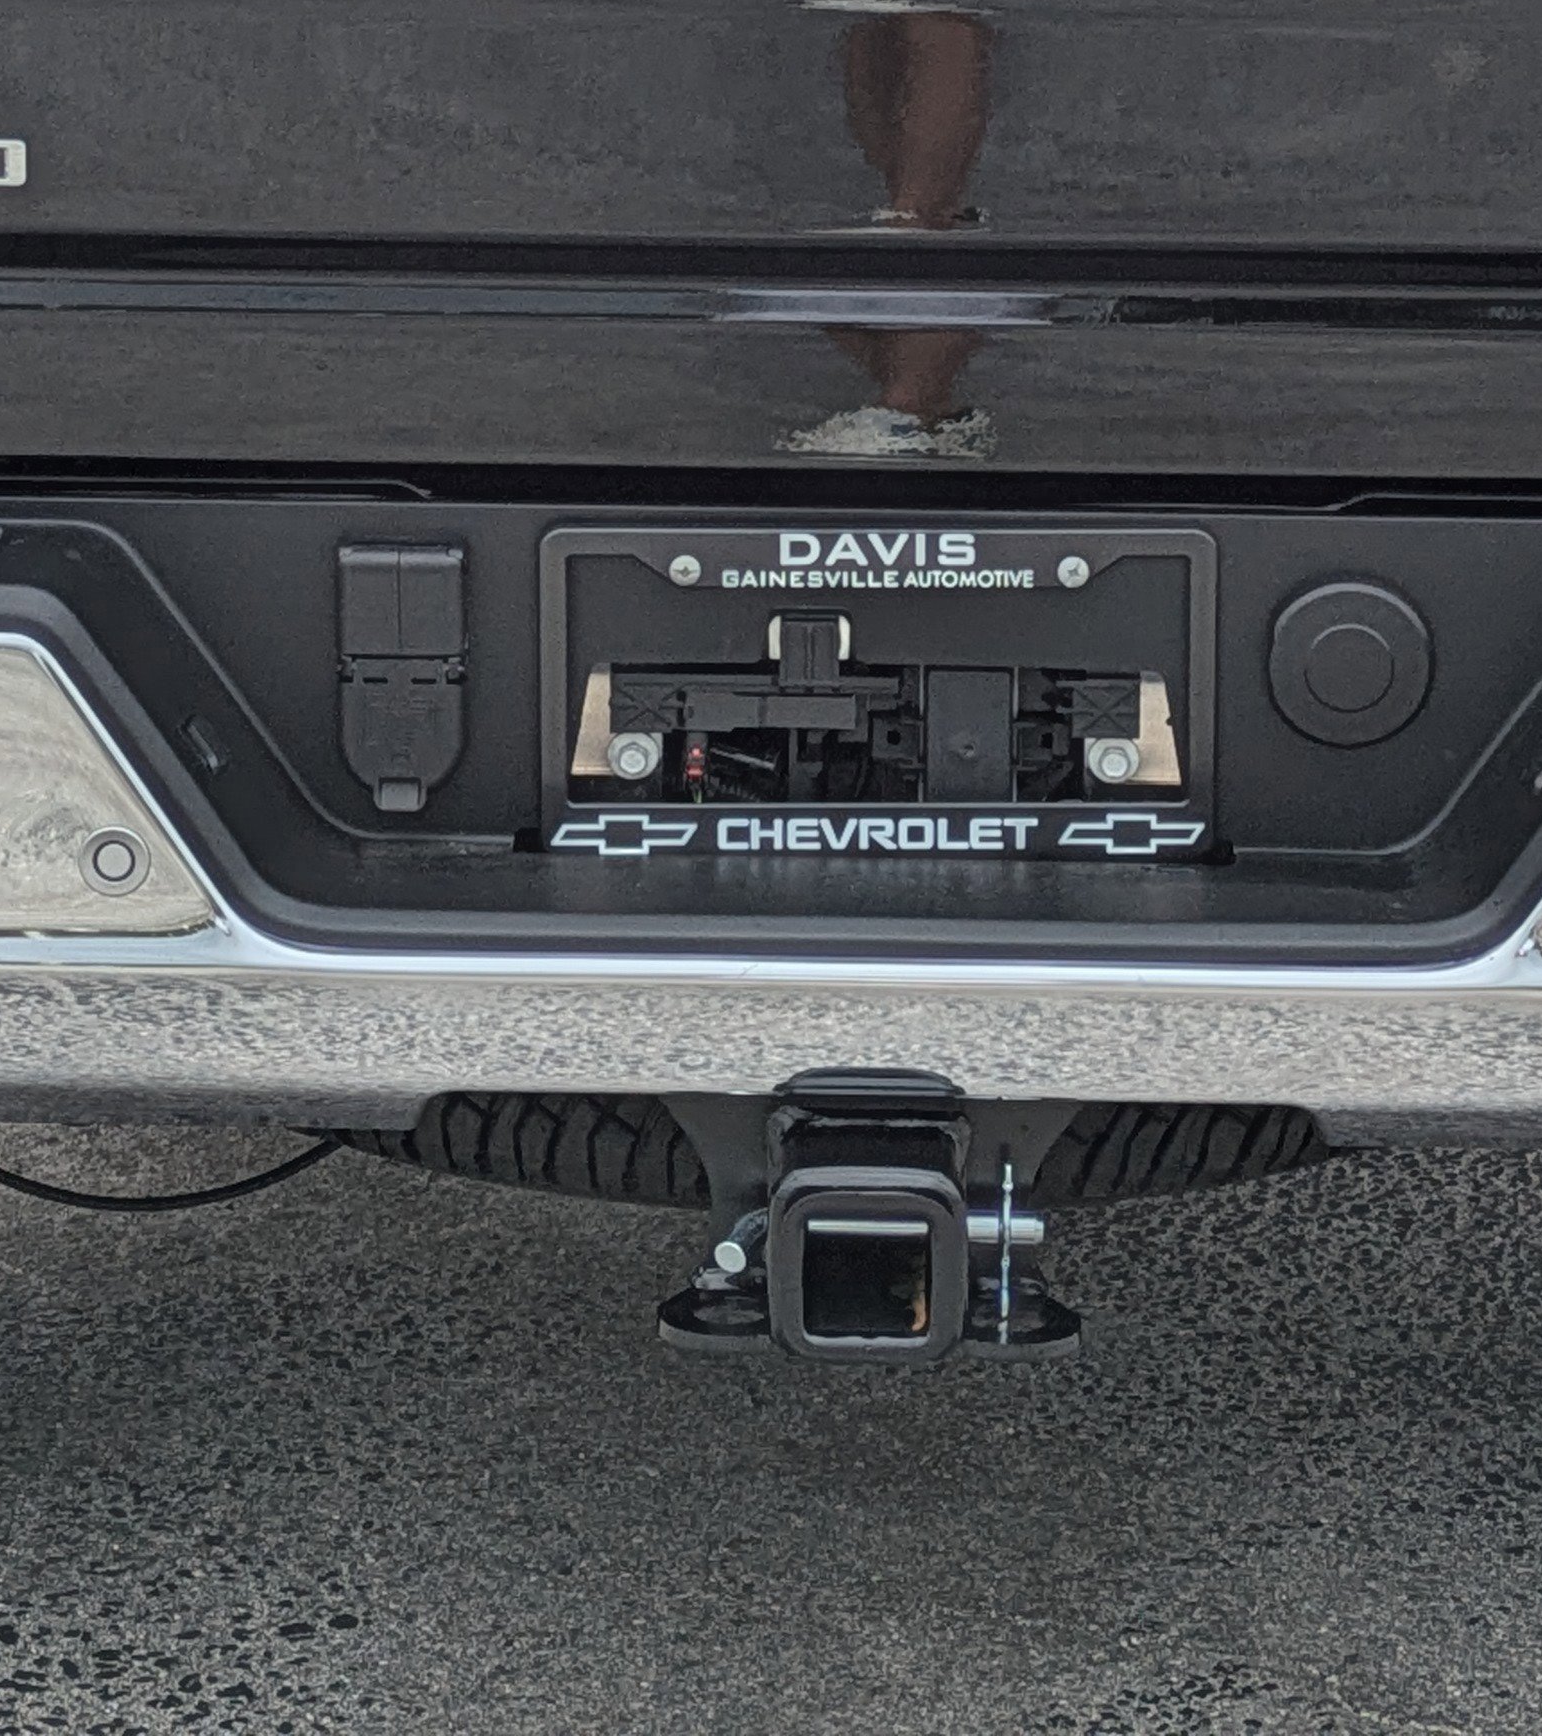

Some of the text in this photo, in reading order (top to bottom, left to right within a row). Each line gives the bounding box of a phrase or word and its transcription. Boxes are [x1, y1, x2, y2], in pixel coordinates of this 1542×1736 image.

[778, 532, 977, 567] DAVIS
[721, 569, 1035, 589] GAINESVILLE AUTOMOTIVE
[716, 817, 1039, 852] CHEVROLET
